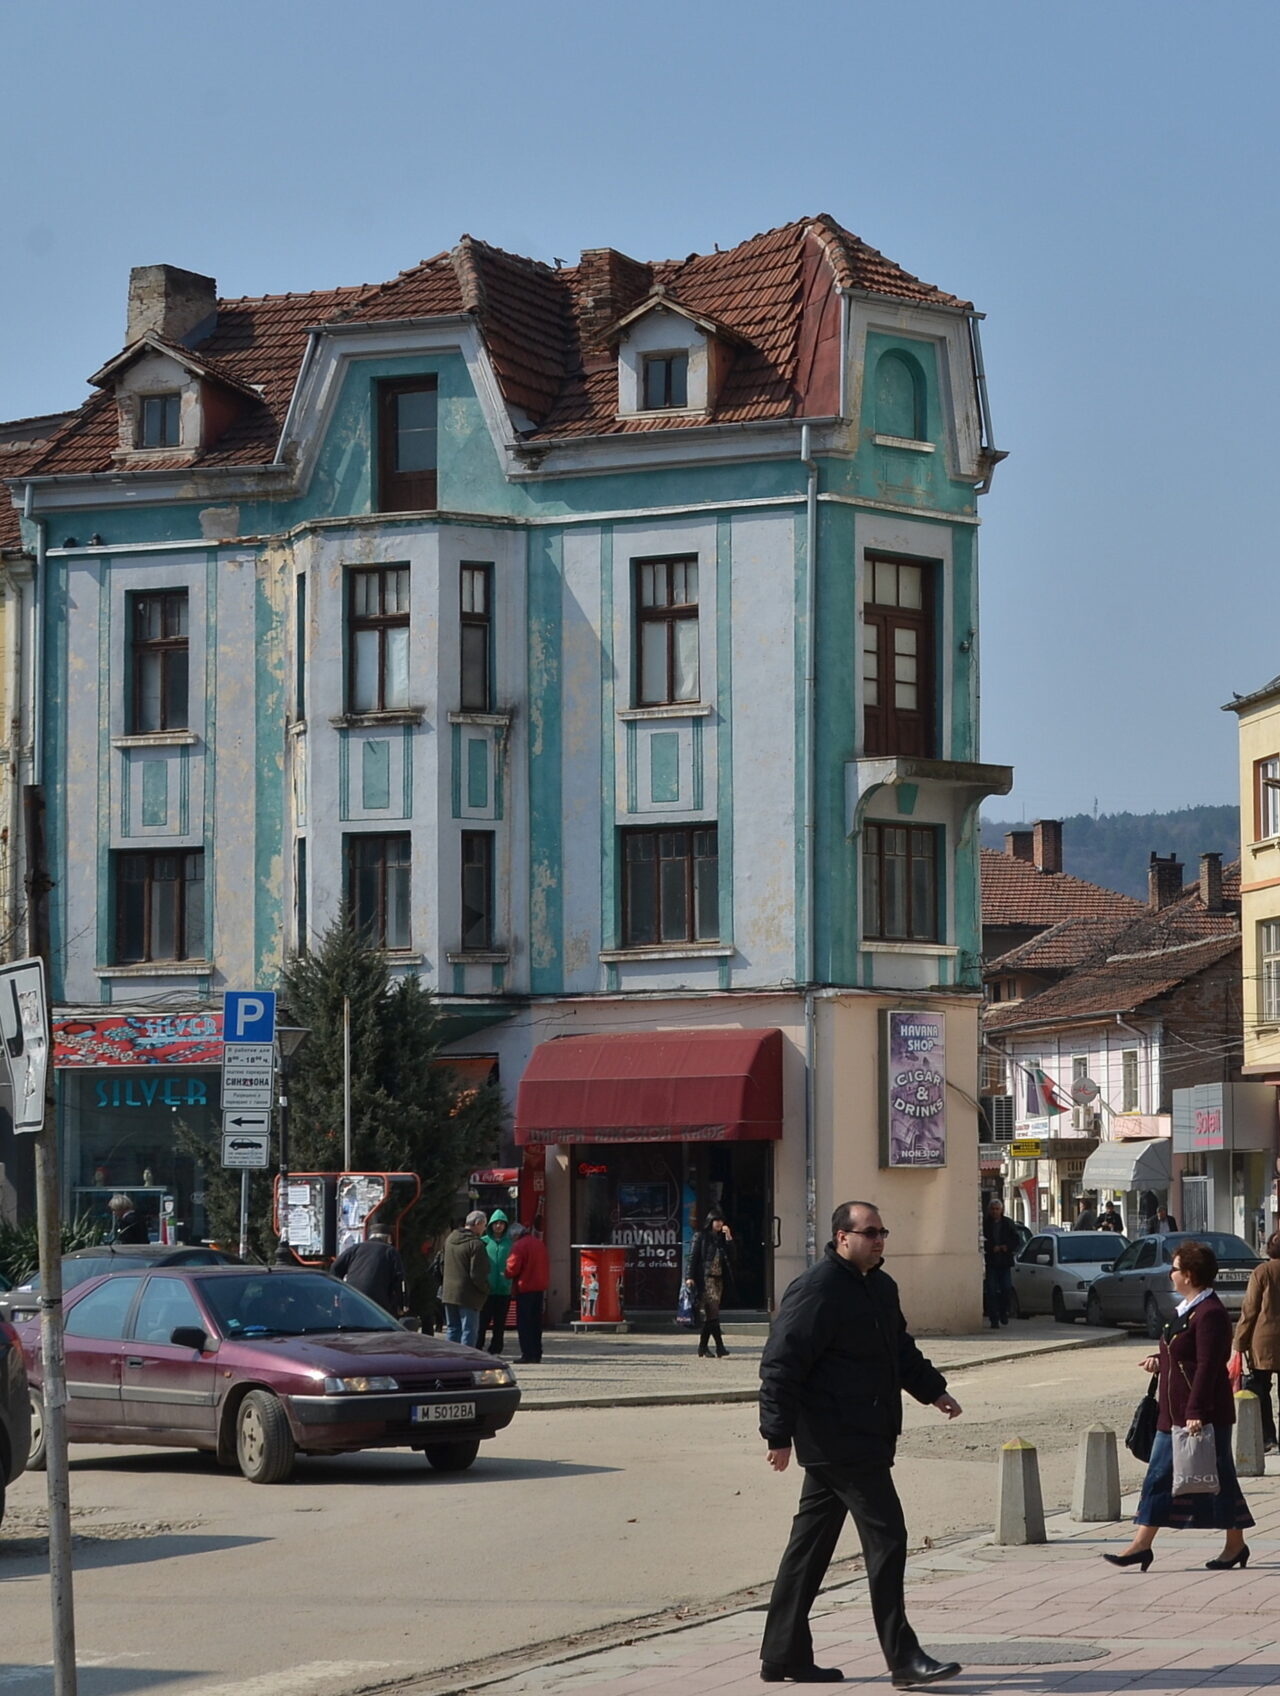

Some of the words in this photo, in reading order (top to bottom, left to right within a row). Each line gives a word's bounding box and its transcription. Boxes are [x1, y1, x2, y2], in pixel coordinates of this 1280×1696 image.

[236, 998, 265, 1036] P
[145, 1017, 217, 1037] SILVER
[900, 1024, 939, 1037] HAVANA
[907, 1039, 934, 1051] SHOP
[896, 1070, 941, 1087] CIGAR
[95, 1077, 207, 1107] SILVER
[916, 1086, 929, 1100] &
[894, 1098, 944, 1117] DRINKS
[611, 1230, 677, 1245] HAVANA
[638, 1246, 677, 1260] shop
[421, 1407, 430, 1420] M
